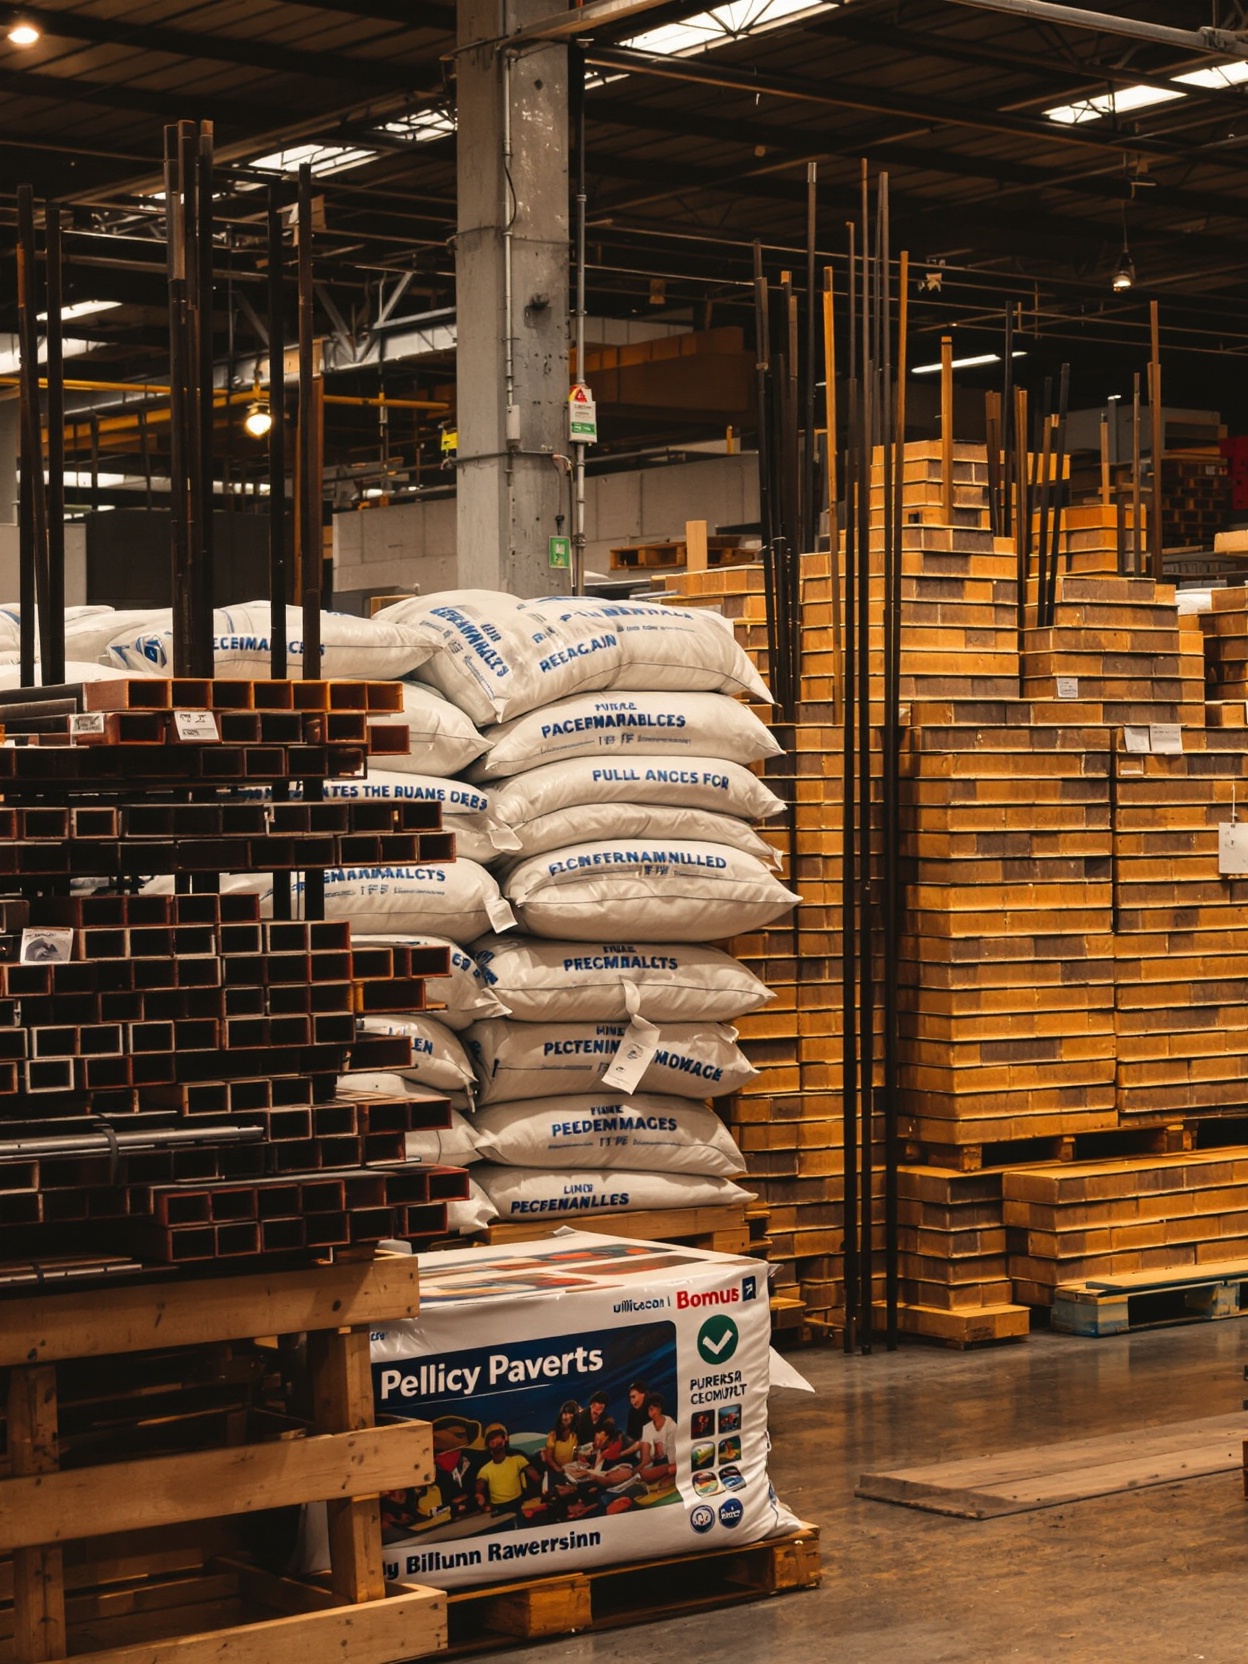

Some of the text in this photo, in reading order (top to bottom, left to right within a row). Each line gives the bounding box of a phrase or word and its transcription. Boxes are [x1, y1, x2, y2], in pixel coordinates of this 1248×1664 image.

[362, 785, 390, 797] THE
[676, 1288, 740, 1310] Bomus
[381, 1346, 604, 1400] Pellicy Paverts
